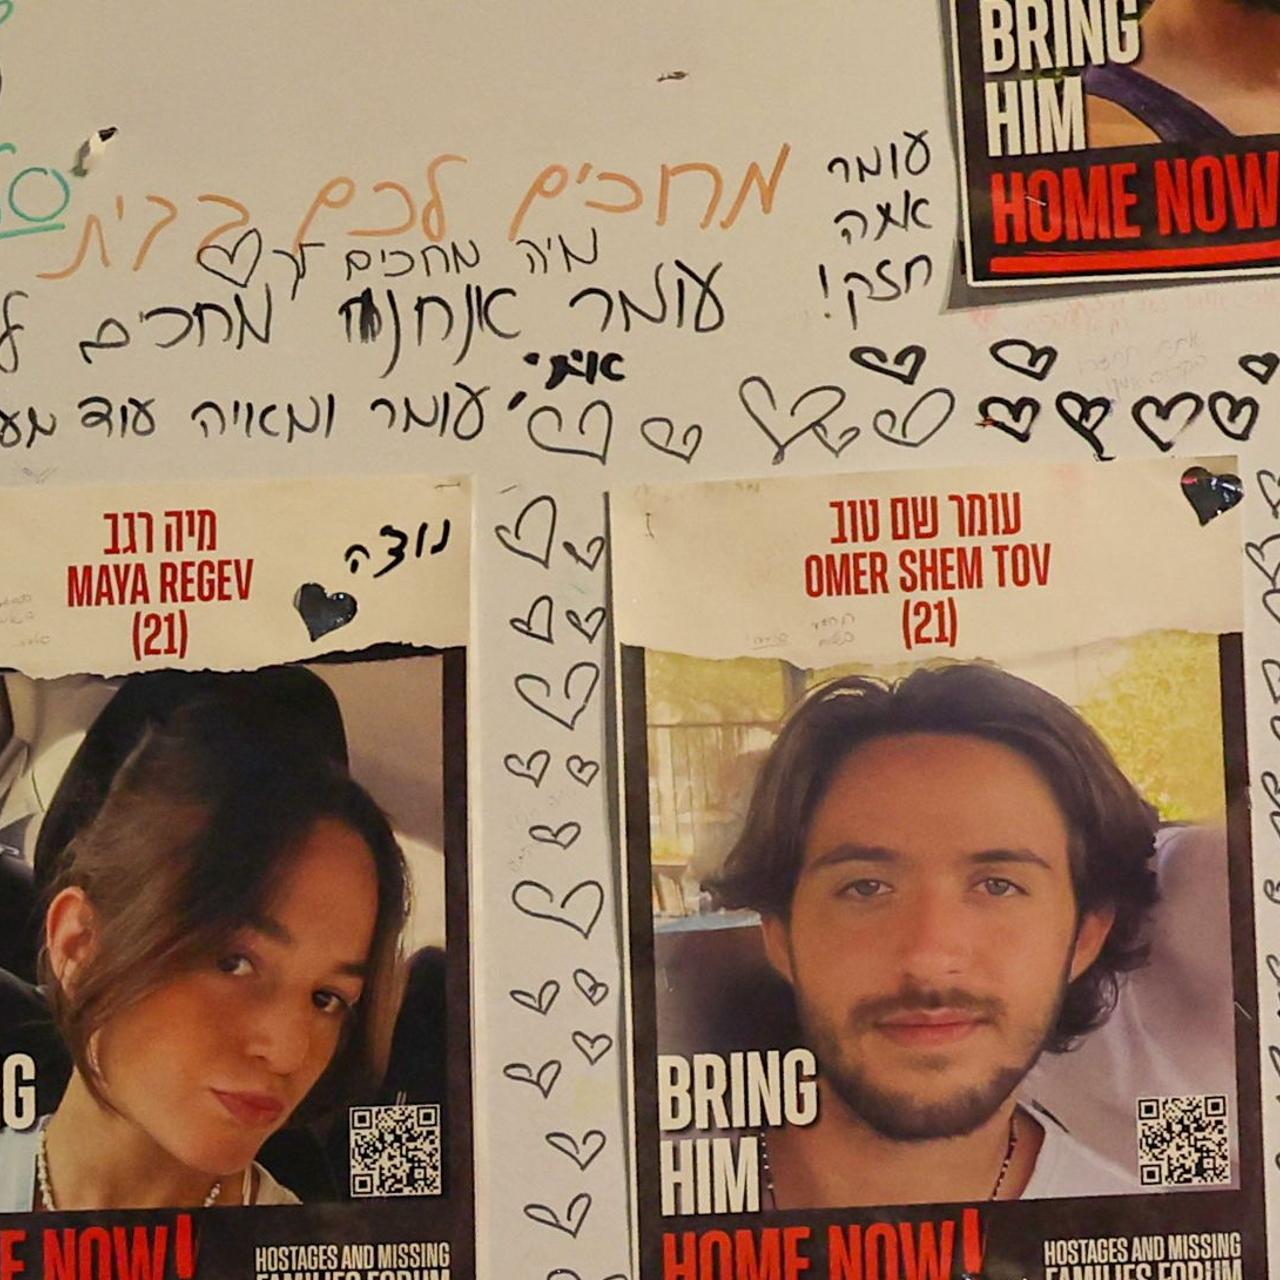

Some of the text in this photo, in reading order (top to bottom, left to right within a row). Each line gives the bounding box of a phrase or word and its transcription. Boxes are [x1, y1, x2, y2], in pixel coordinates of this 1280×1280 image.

[980, 0, 1140, 73] BRING
[985, 75, 1086, 157] HIM
[990, 162, 1141, 244] HOME
[104, 508, 218, 555] מיה רגב
[829, 492, 1022, 545] עומר שם טוב
[67, 558, 254, 607] MAYA REGEV
[805, 543, 1052, 599] OMER SHEM TOV
[133, 610, 188, 657] (21)
[903, 598, 958, 650] (21)
[658, 1049, 816, 1131] BRING
[660, 1137, 759, 1215] HIM
[256, 1243, 449, 1271] HOSTAGES AND MISSING
[1045, 1233, 1241, 1265] HOSTAGES AND MISSING
